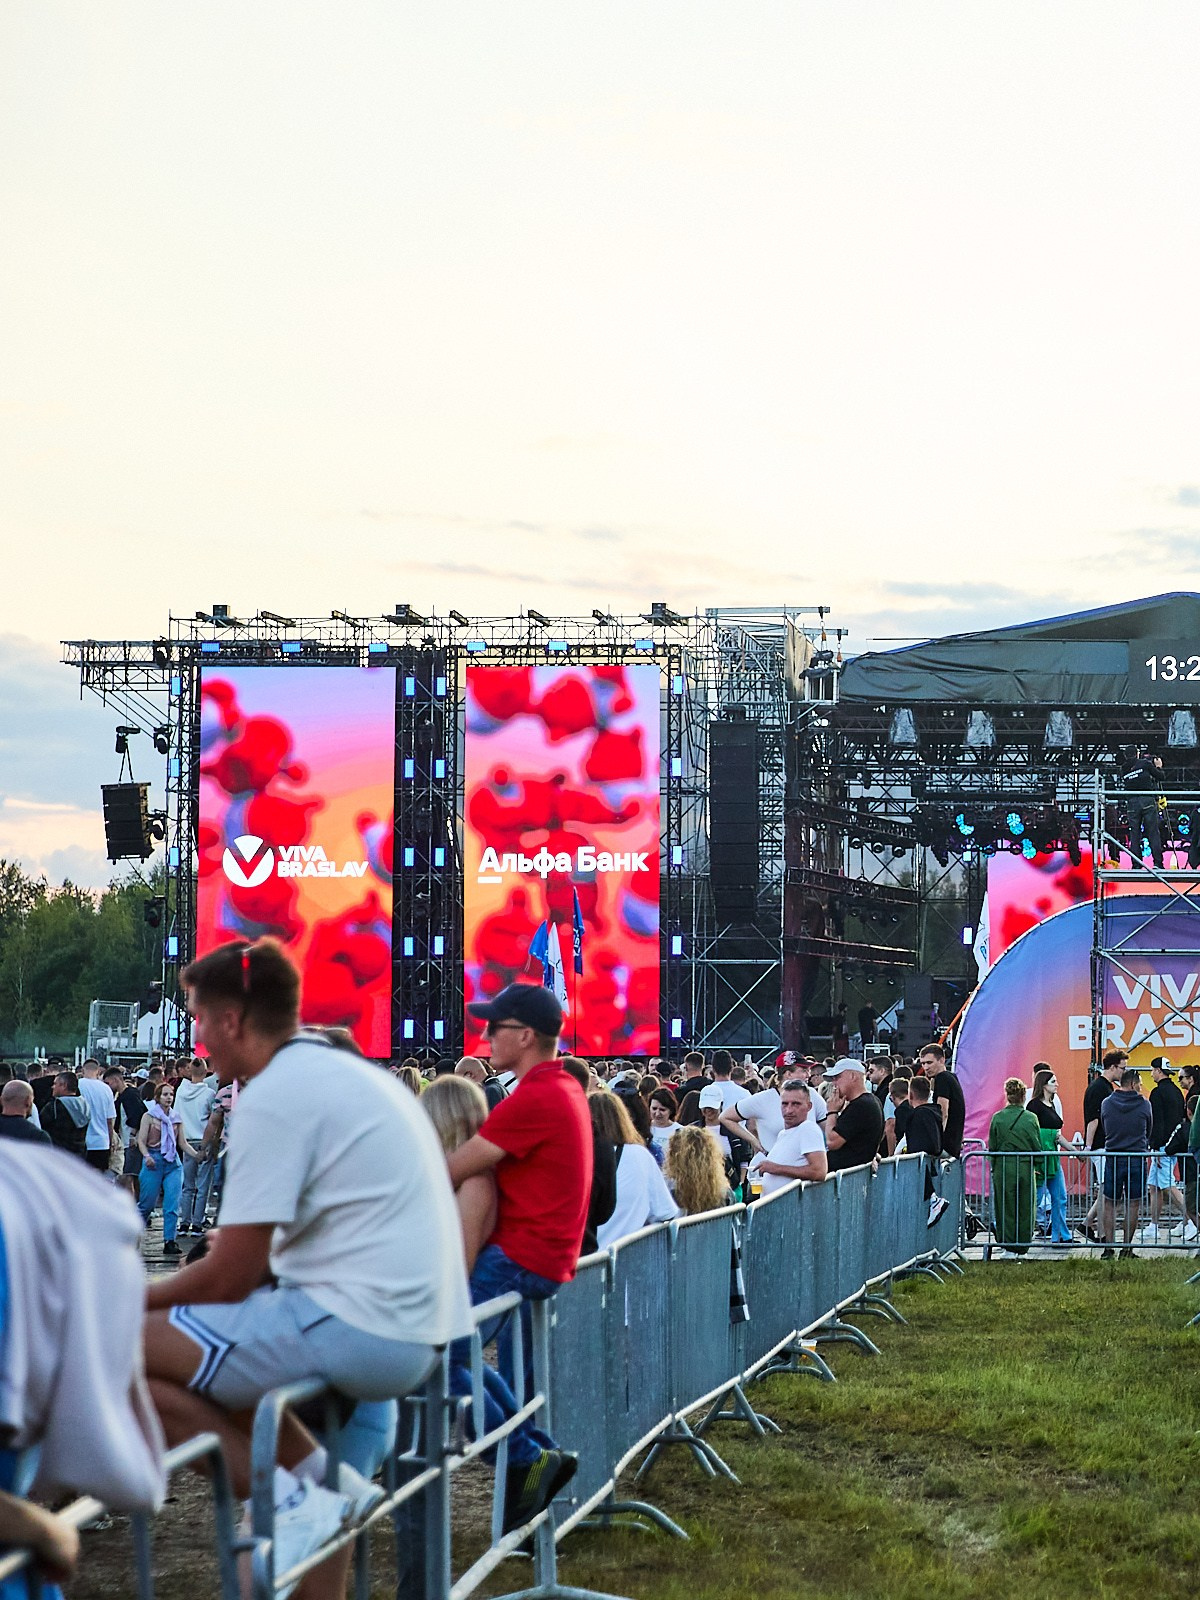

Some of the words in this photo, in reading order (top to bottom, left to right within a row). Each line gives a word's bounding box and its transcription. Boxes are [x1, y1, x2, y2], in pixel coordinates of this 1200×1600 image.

[278, 845, 328, 861] VIVA
[277, 861, 369, 877] BRASLAV
[478, 846, 573, 879] Альфа
[577, 846, 650, 872] Банк
